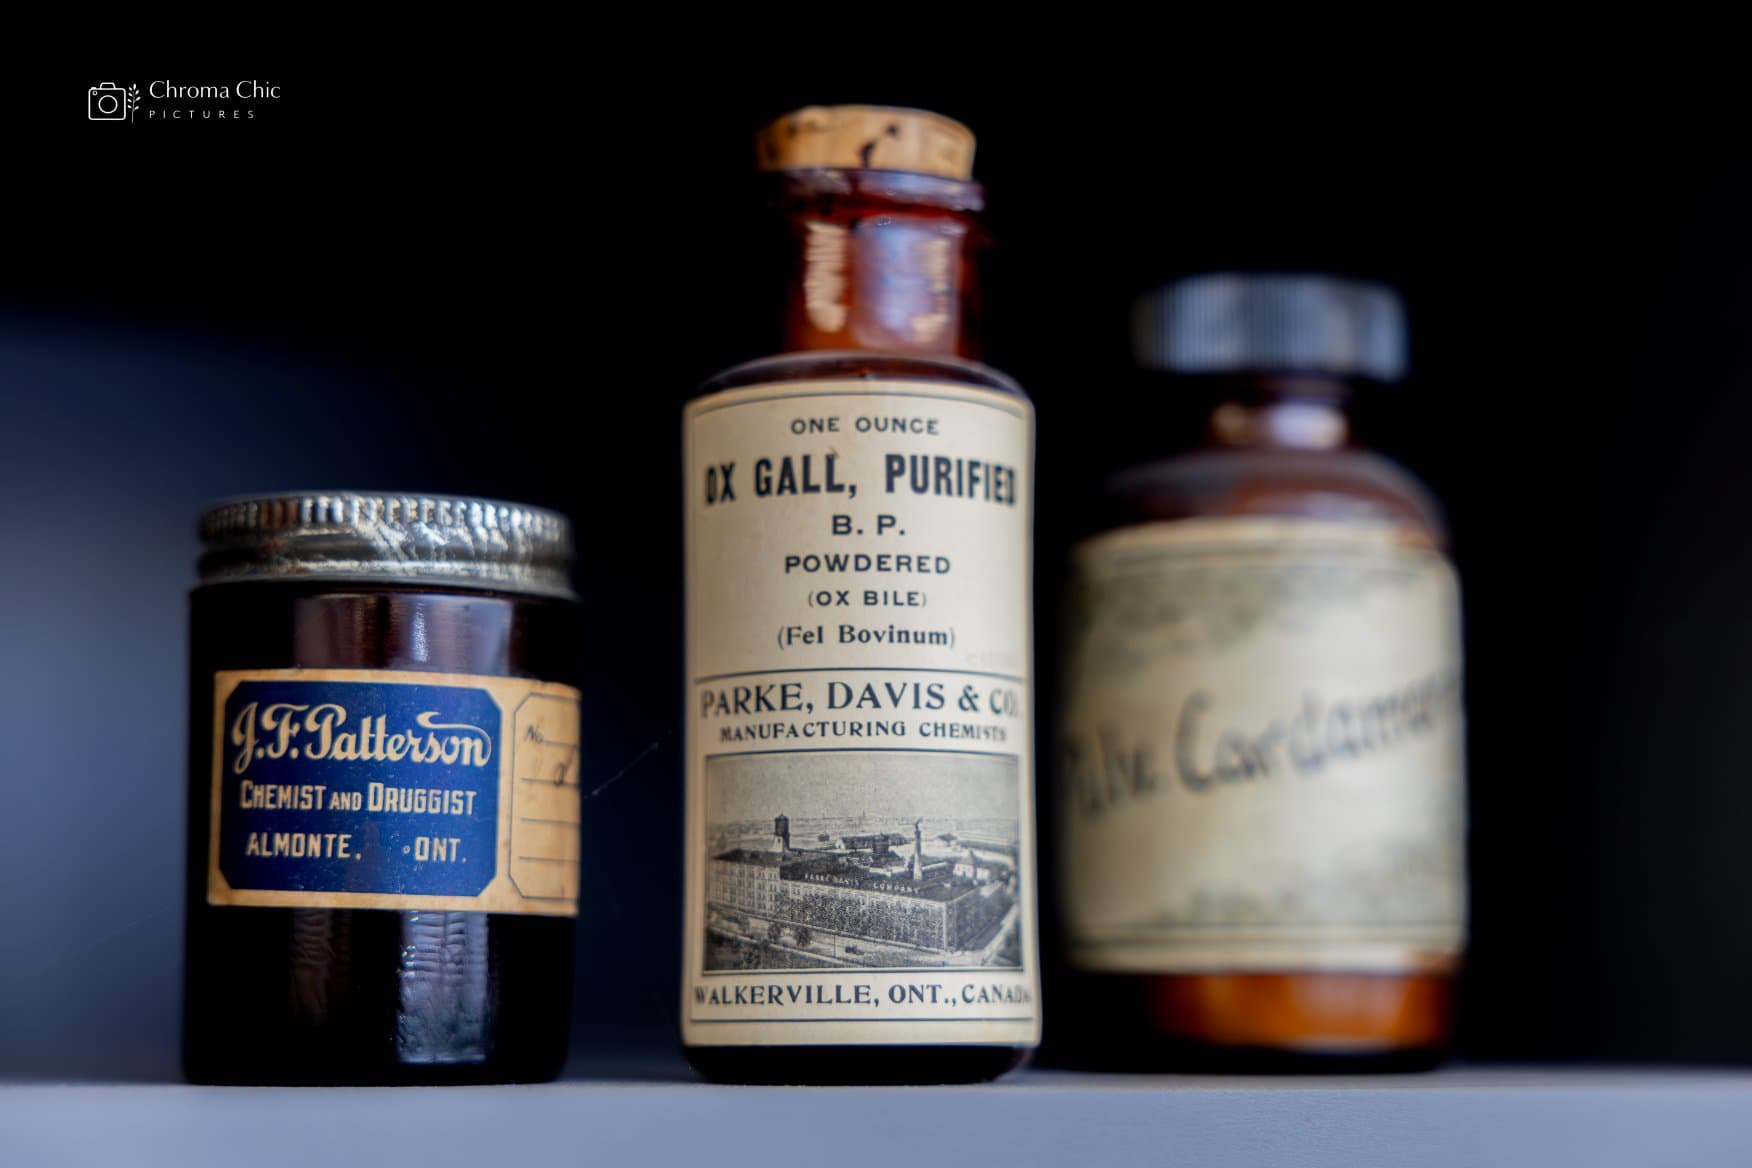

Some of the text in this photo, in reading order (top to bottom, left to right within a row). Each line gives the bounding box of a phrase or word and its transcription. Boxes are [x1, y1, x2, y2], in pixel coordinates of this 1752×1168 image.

[791, 417, 940, 435] ONE OUNCE
[705, 454, 1017, 506] OX GALL, PURIFIED
[832, 515, 905, 535] B. P.
[784, 554, 951, 574] POWDERED
[808, 591, 927, 608] (OX BILE)
[777, 625, 956, 650] (Fel Bovinum)
[702, 682, 814, 717] PARKE,
[827, 682, 946, 710] DAVIS
[957, 684, 980, 712] &
[720, 721, 1007, 743] MANUFACTURING CHEMISTS
[240, 780, 478, 816] CHEMIST AND DRUGGIST
[694, 983, 879, 1008] WALKERVILLE,
[888, 983, 957, 1006] ONT.,
